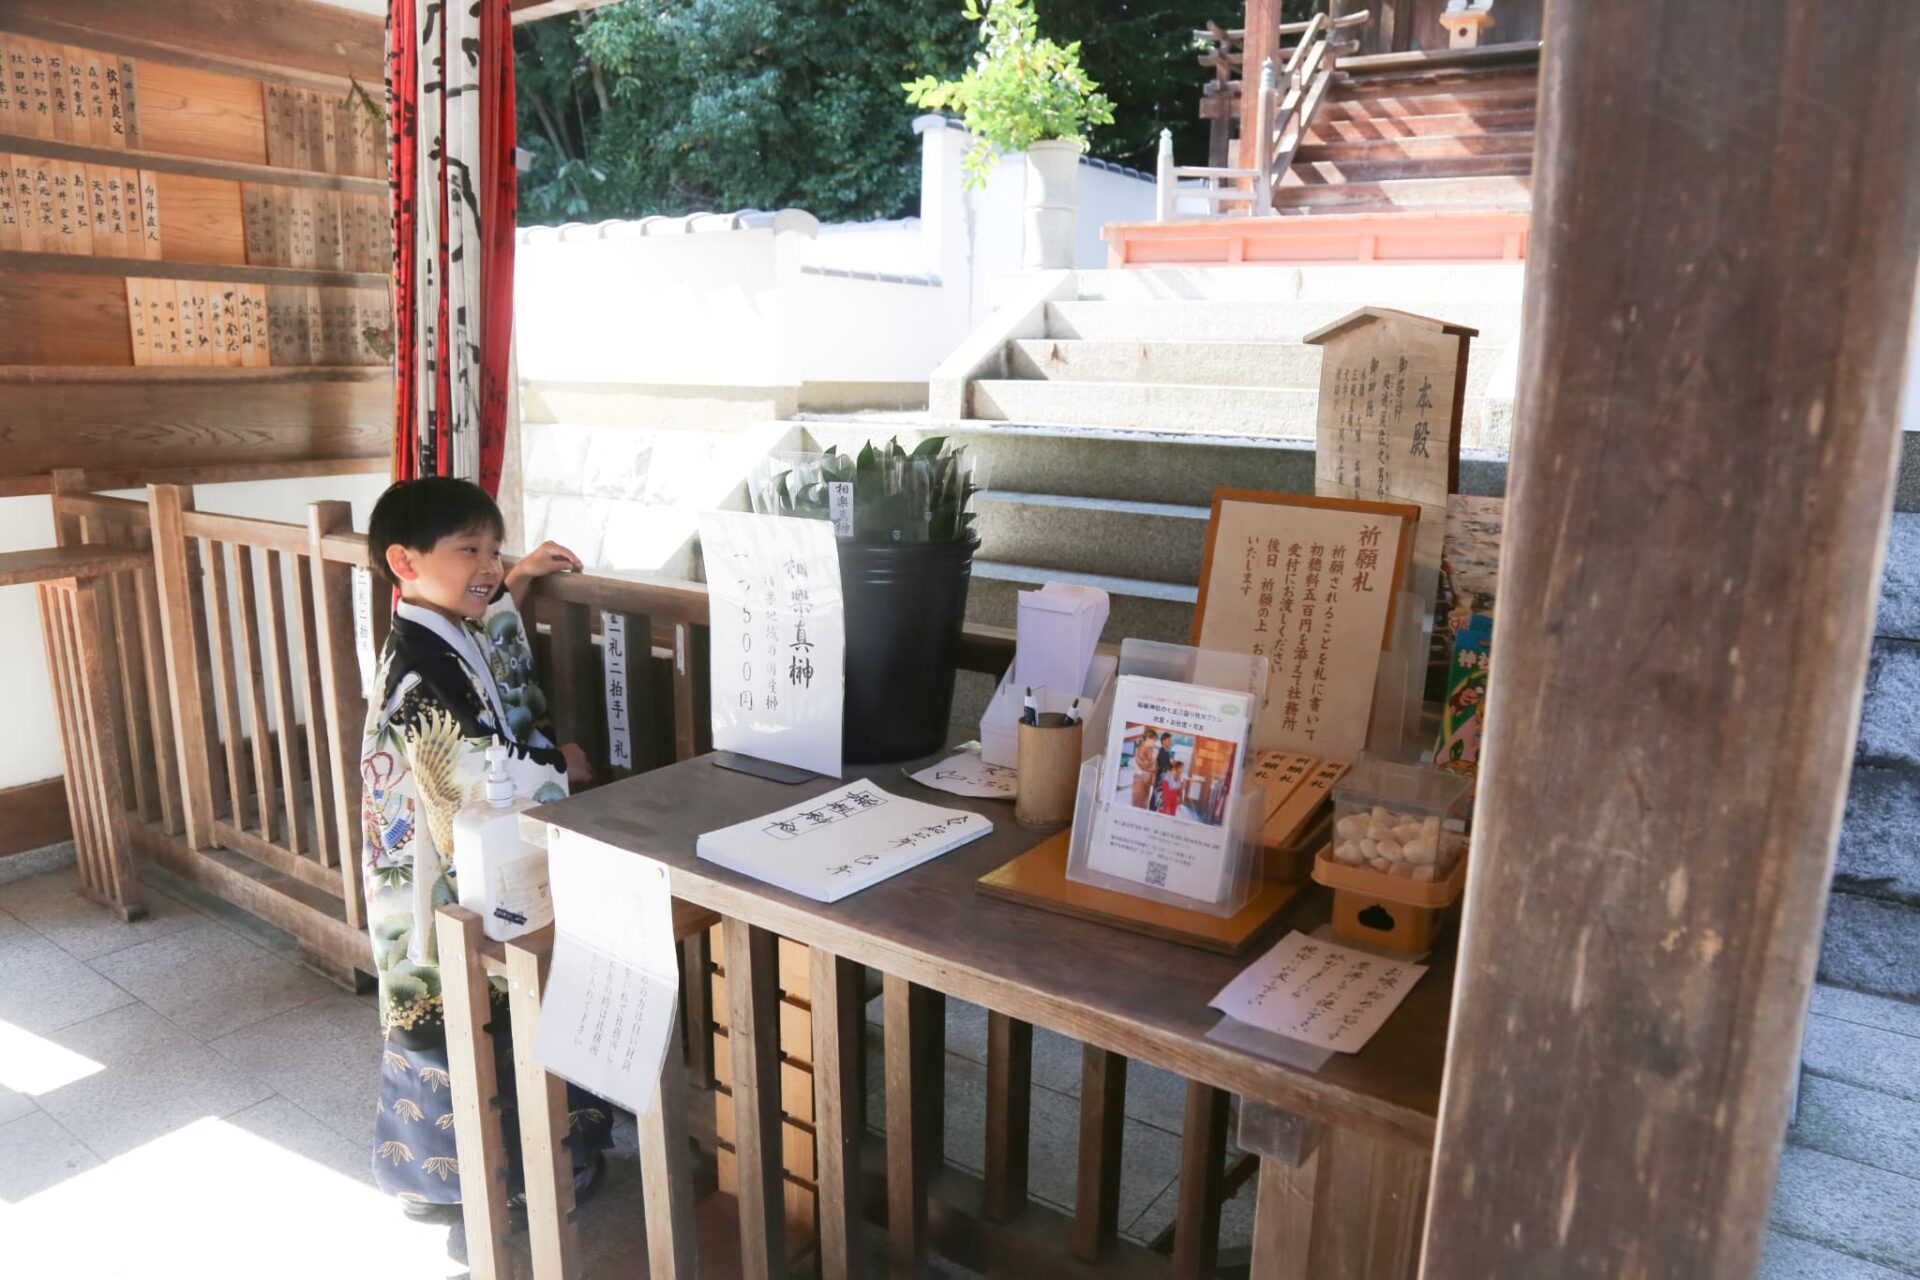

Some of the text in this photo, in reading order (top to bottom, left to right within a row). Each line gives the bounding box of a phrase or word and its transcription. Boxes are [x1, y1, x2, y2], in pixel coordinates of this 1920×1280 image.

[1410, 376, 1433, 459] 本殿
[1240, 535, 1259, 596] いたします
[1351, 525, 1382, 593] 祈願札
[1270, 541, 1303, 674] 受付にお渡しください
[1305, 544, 1348, 741] 祈願されることを札に書いて
